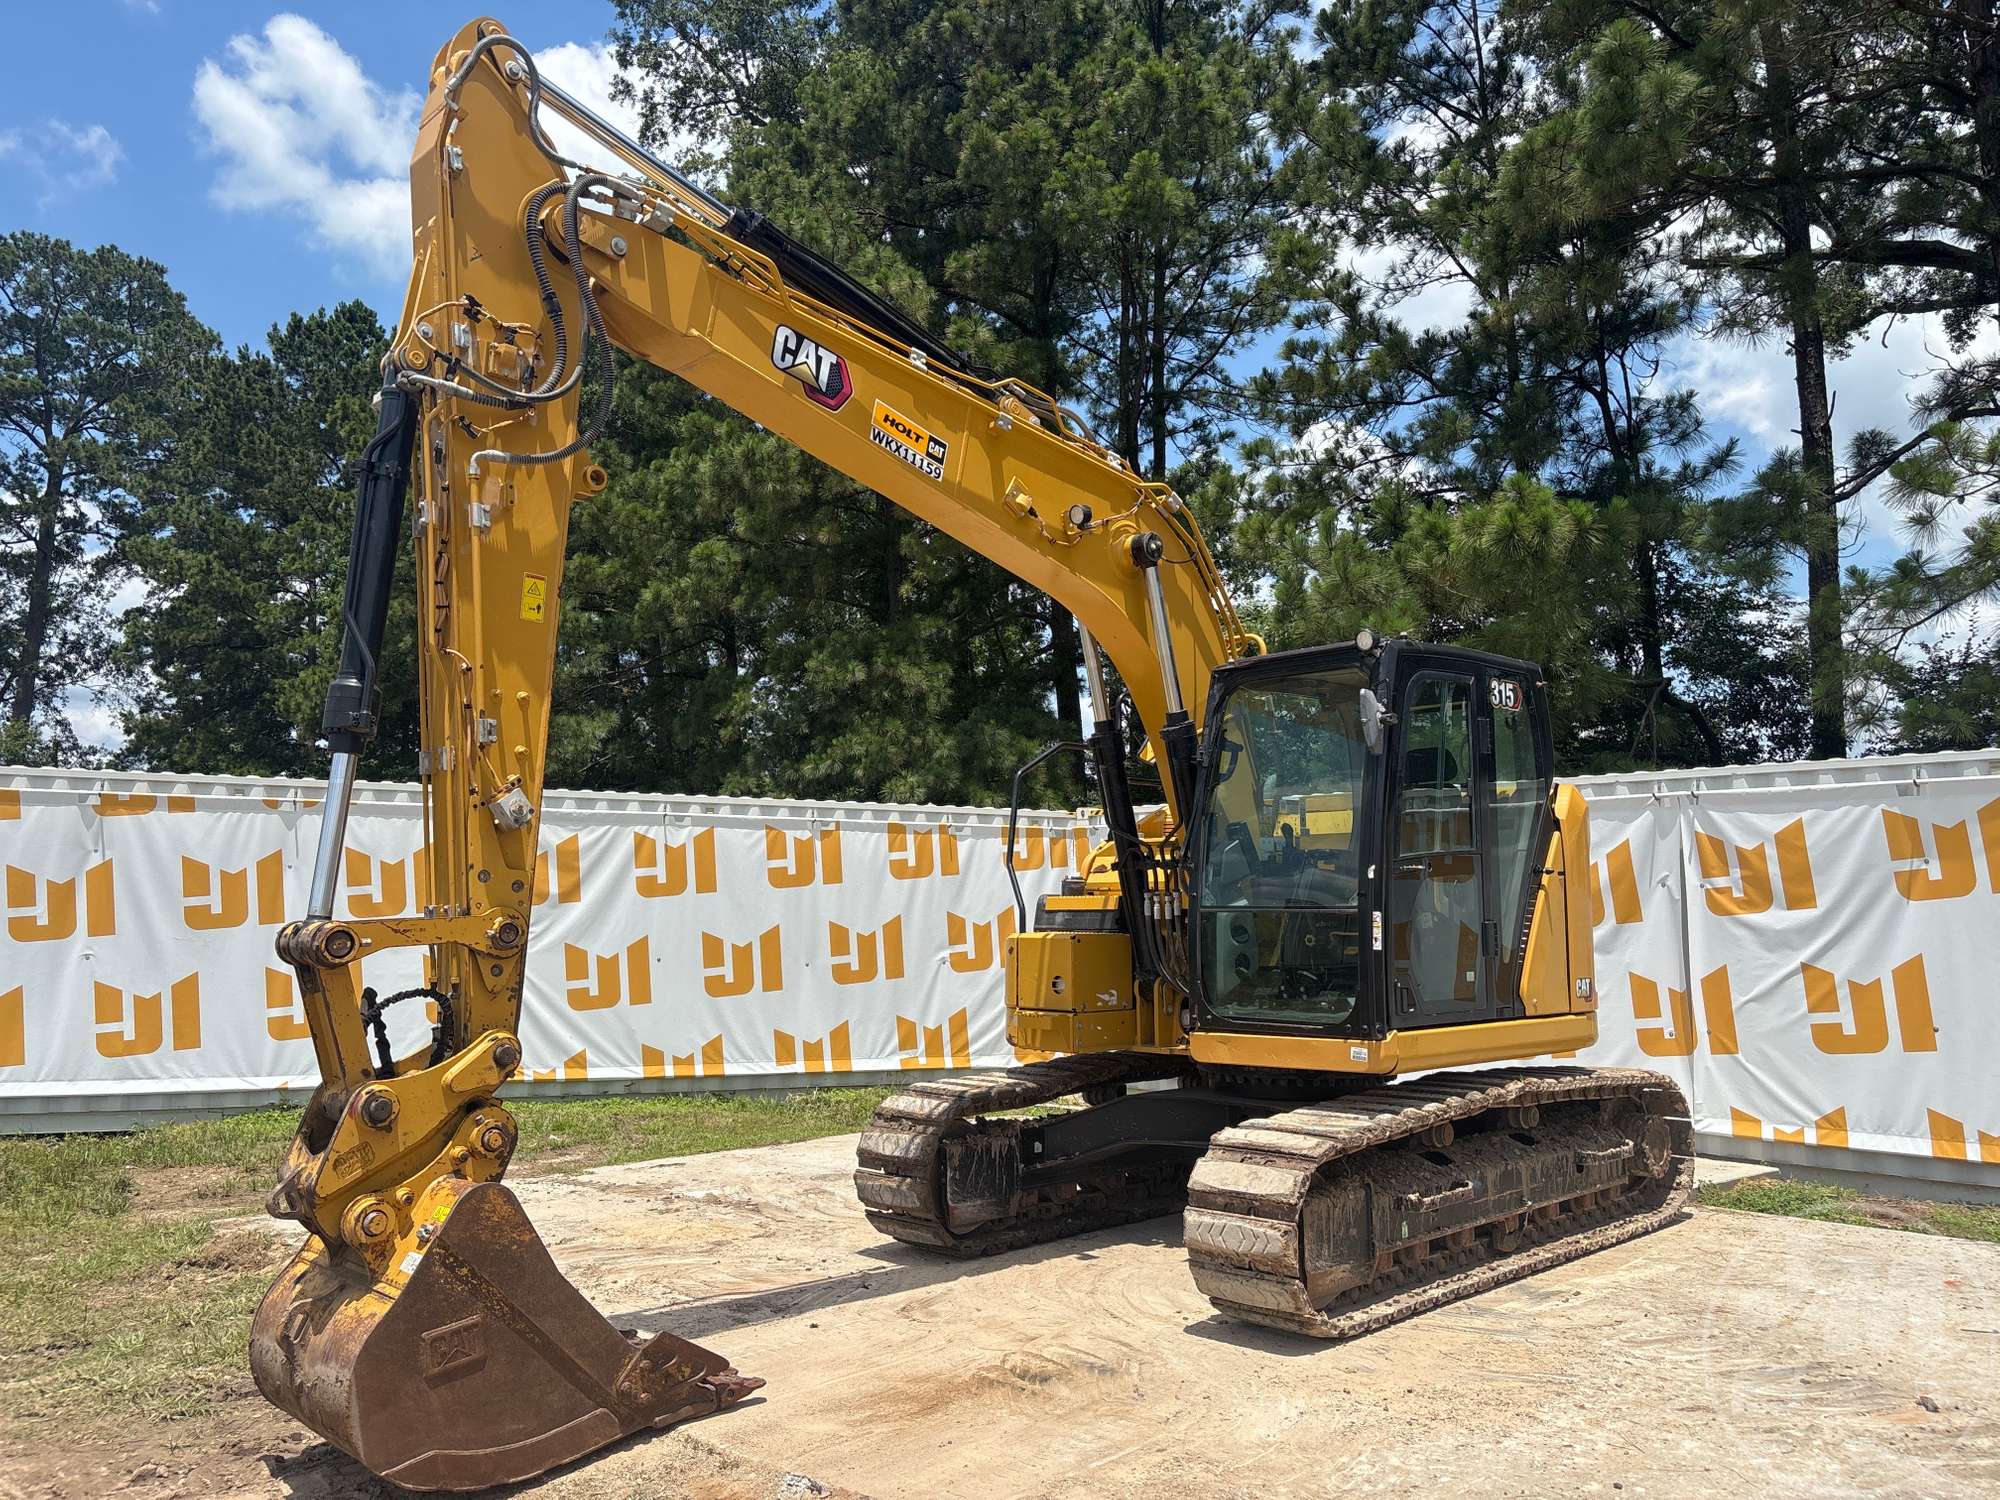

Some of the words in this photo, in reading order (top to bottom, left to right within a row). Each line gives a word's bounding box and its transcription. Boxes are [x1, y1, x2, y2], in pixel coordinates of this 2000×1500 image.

[773, 325, 837, 392] CAT
[883, 413, 924, 444] HOLT
[872, 427, 942, 480] WKX11159
[928, 441, 945, 458] CAT
[1491, 680, 1514, 707] 315
[1576, 978, 1591, 998] CAT
